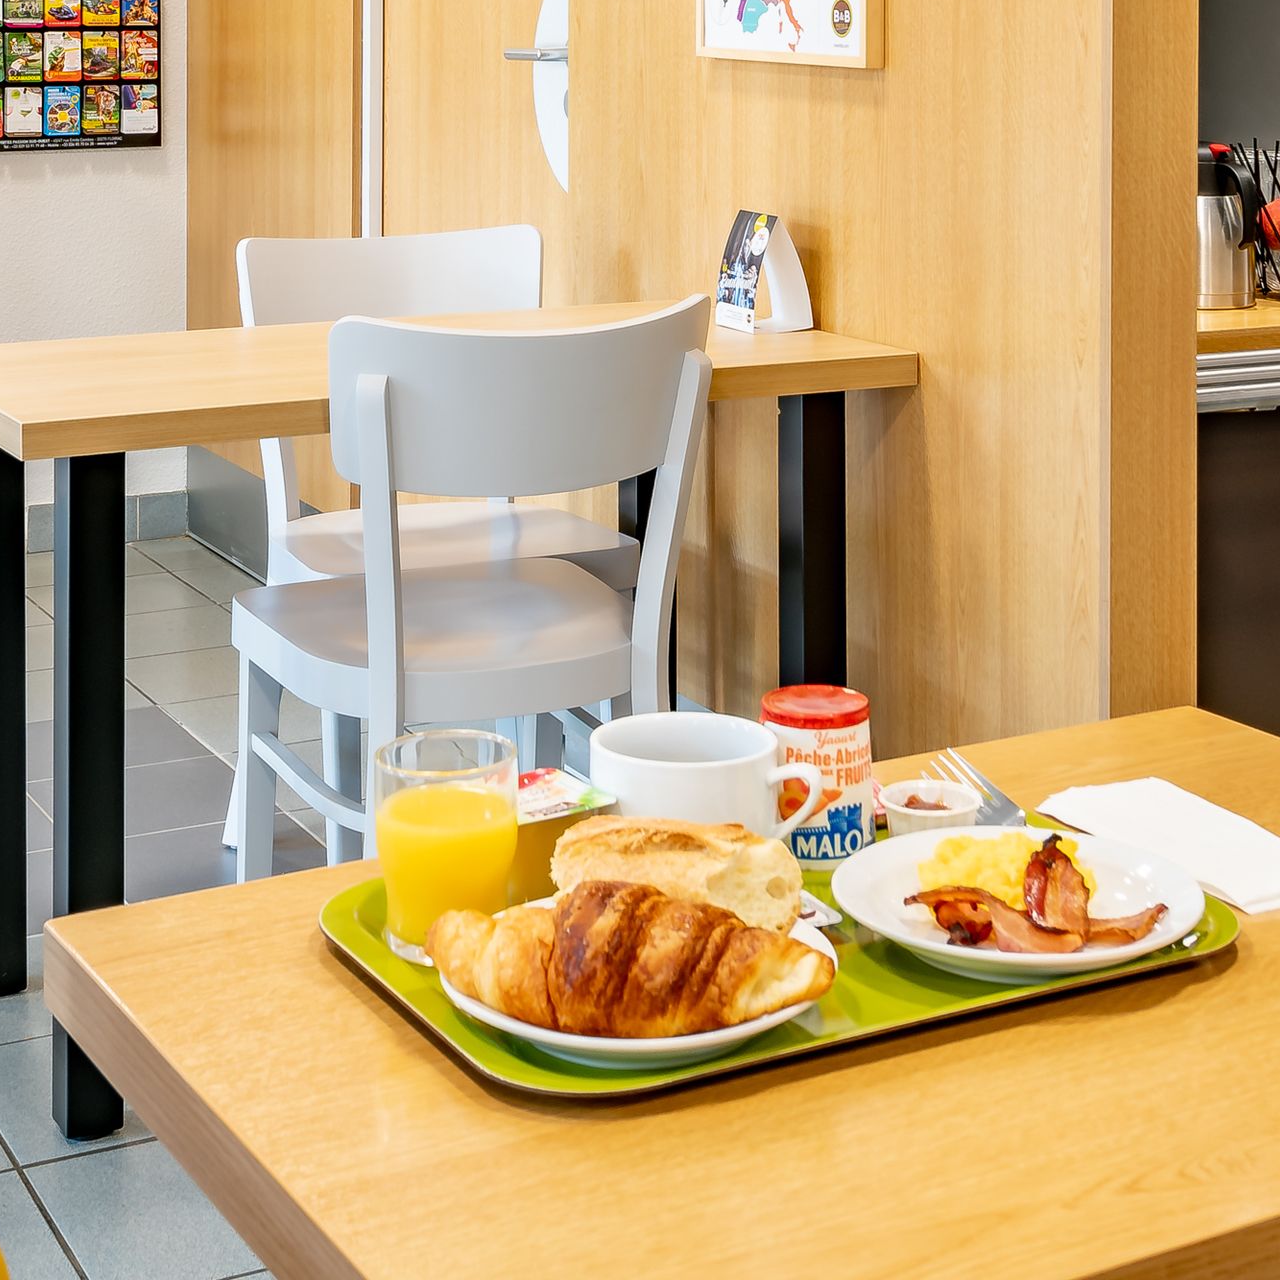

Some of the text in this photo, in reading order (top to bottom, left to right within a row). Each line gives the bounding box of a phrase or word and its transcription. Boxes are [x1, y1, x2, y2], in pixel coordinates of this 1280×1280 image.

[833, 9, 851, 24] B&B
[814, 730, 857, 749] Yaourt
[796, 829, 862, 858] MALO
